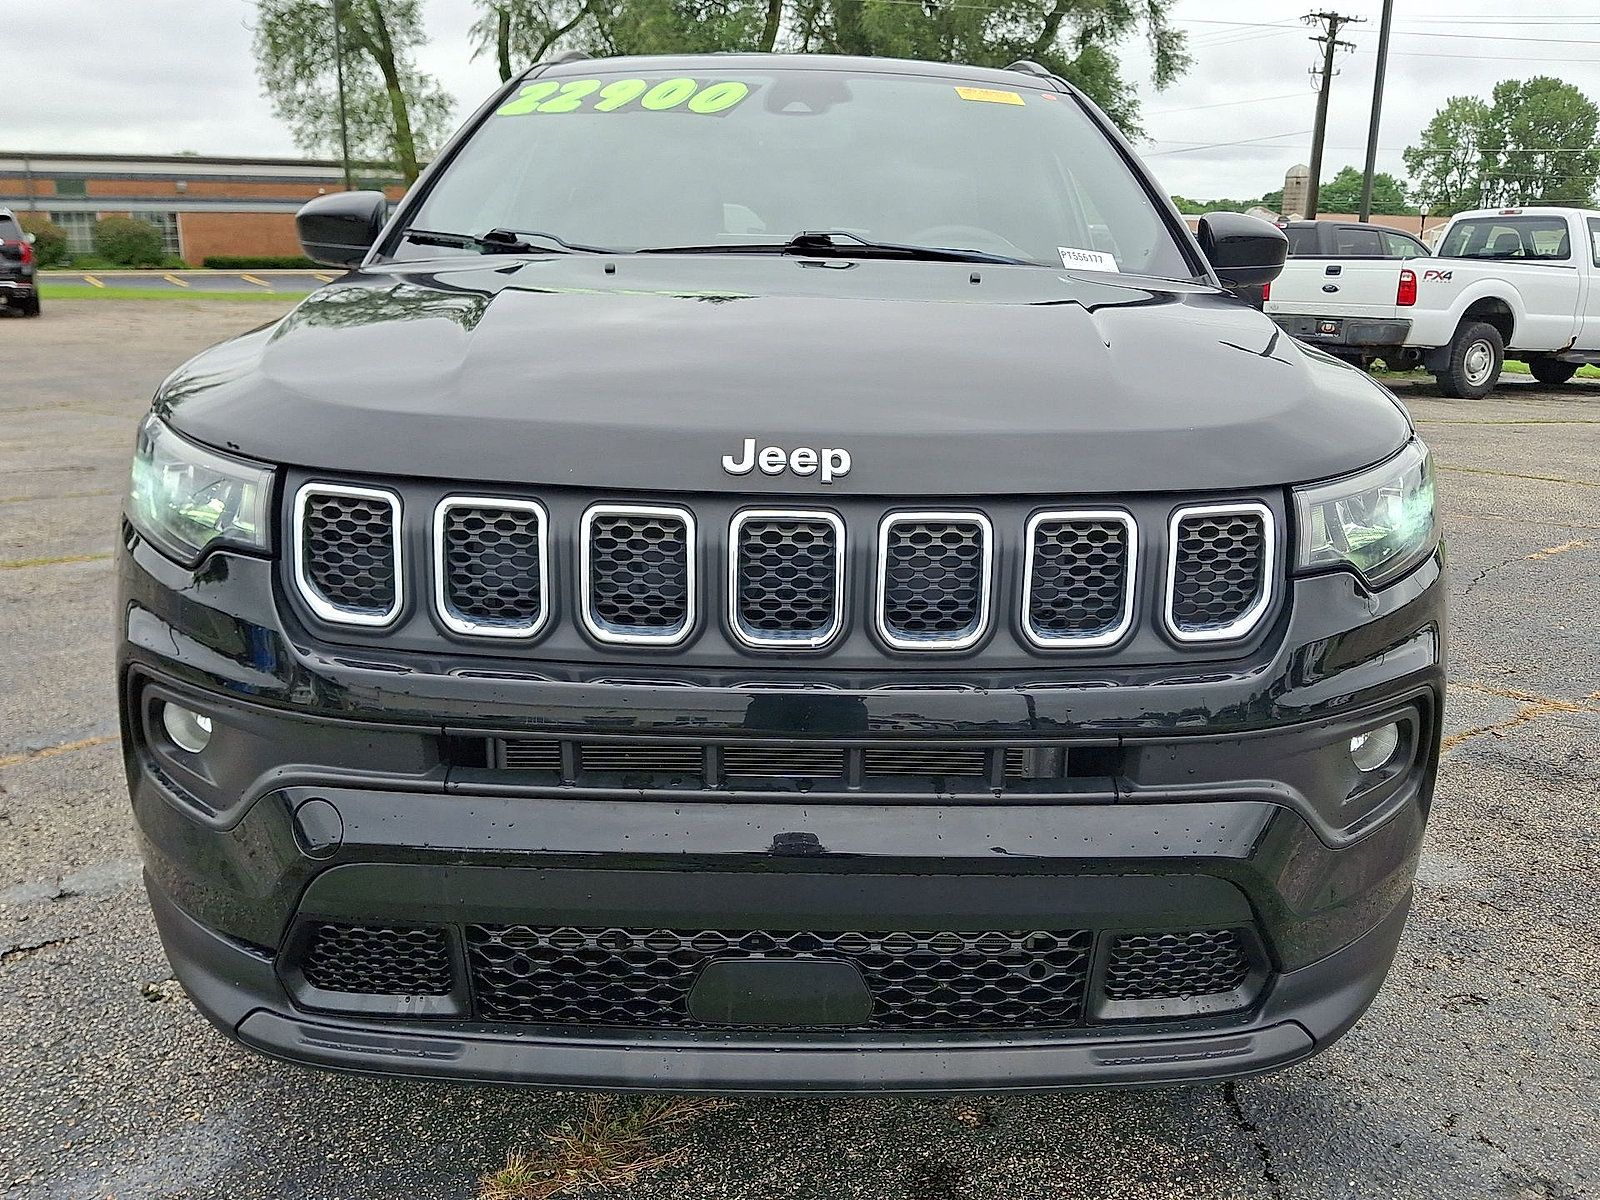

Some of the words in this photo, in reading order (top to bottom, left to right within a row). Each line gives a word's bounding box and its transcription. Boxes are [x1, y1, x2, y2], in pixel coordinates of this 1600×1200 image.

[496, 78, 749, 115] 22900
[1423, 270, 1453, 280] FX4
[721, 438, 852, 484] Jeep
